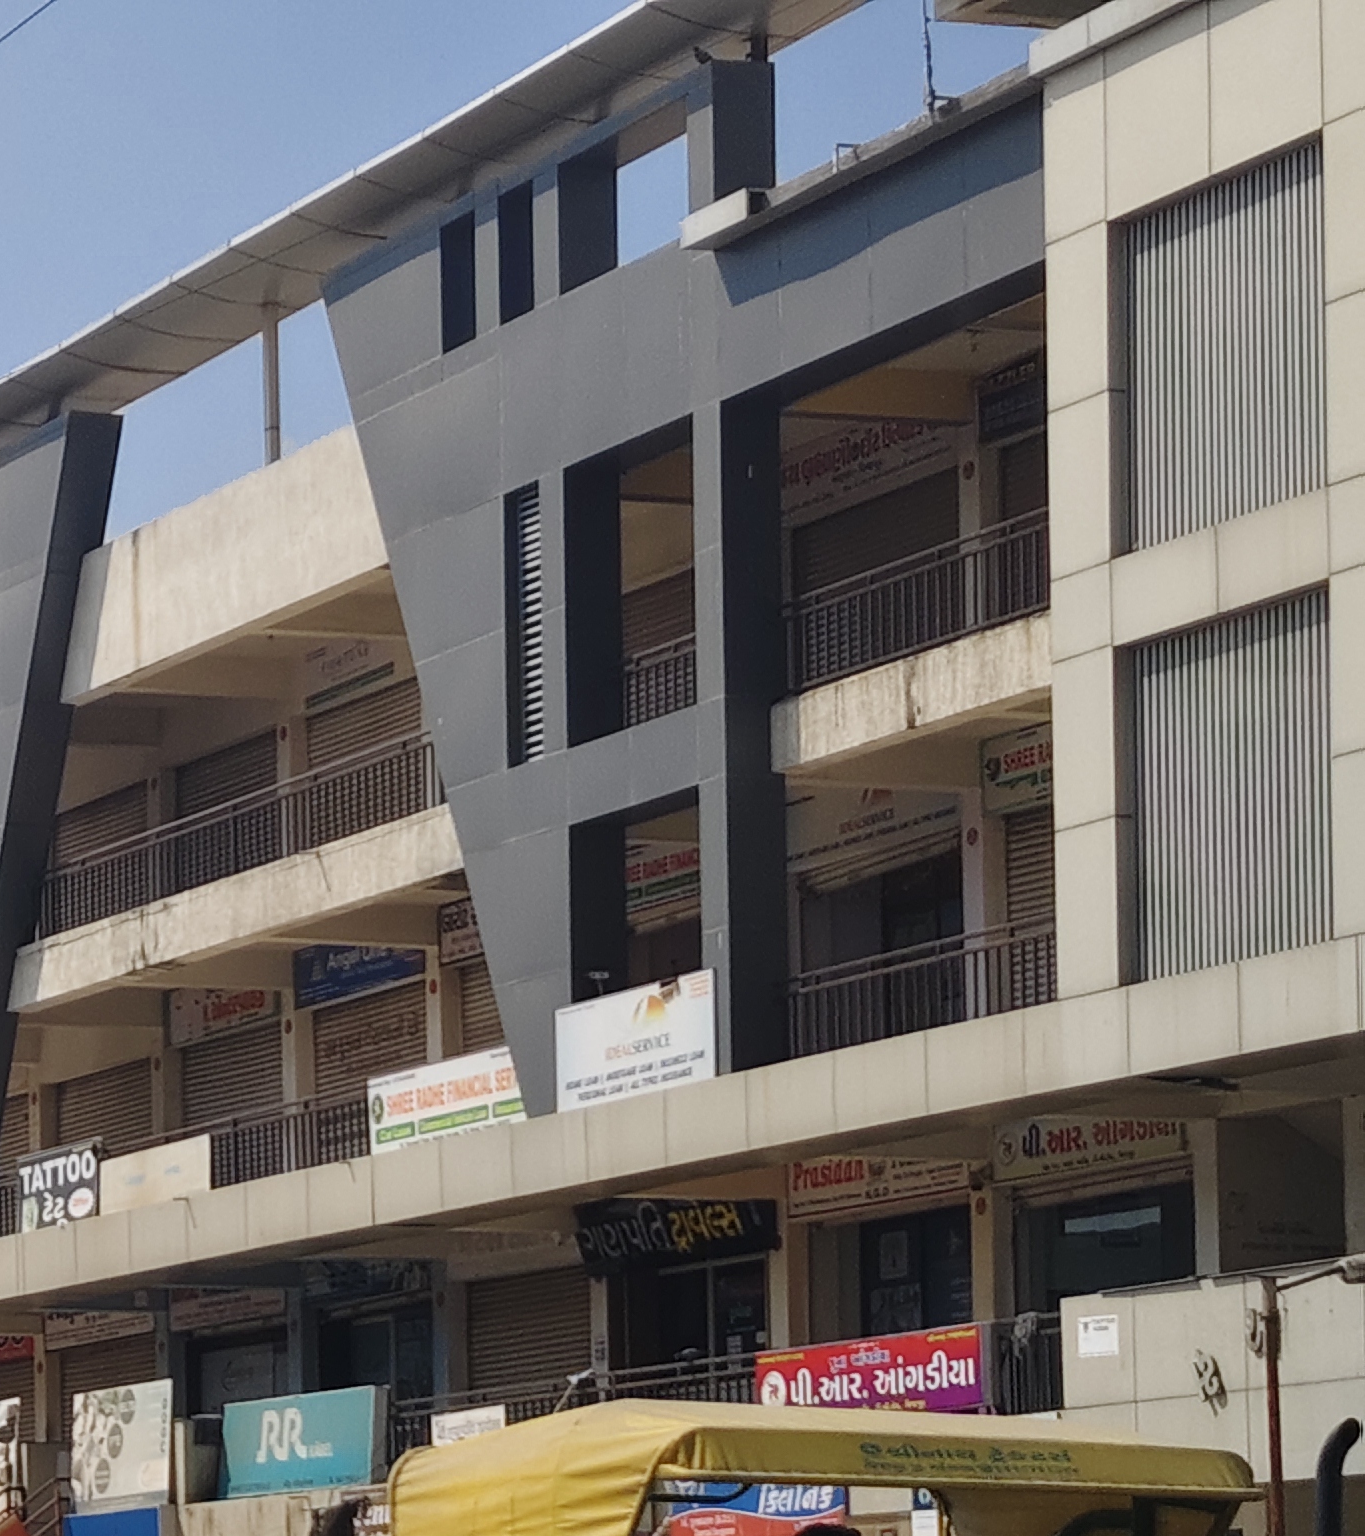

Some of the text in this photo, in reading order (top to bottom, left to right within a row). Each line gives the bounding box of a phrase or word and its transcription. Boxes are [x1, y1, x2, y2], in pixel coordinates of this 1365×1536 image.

[19, 1149, 97, 1195] TATTOO
[872, 1350, 976, 1396] આંગડીયા
[255, 1407, 307, 1464] RR
